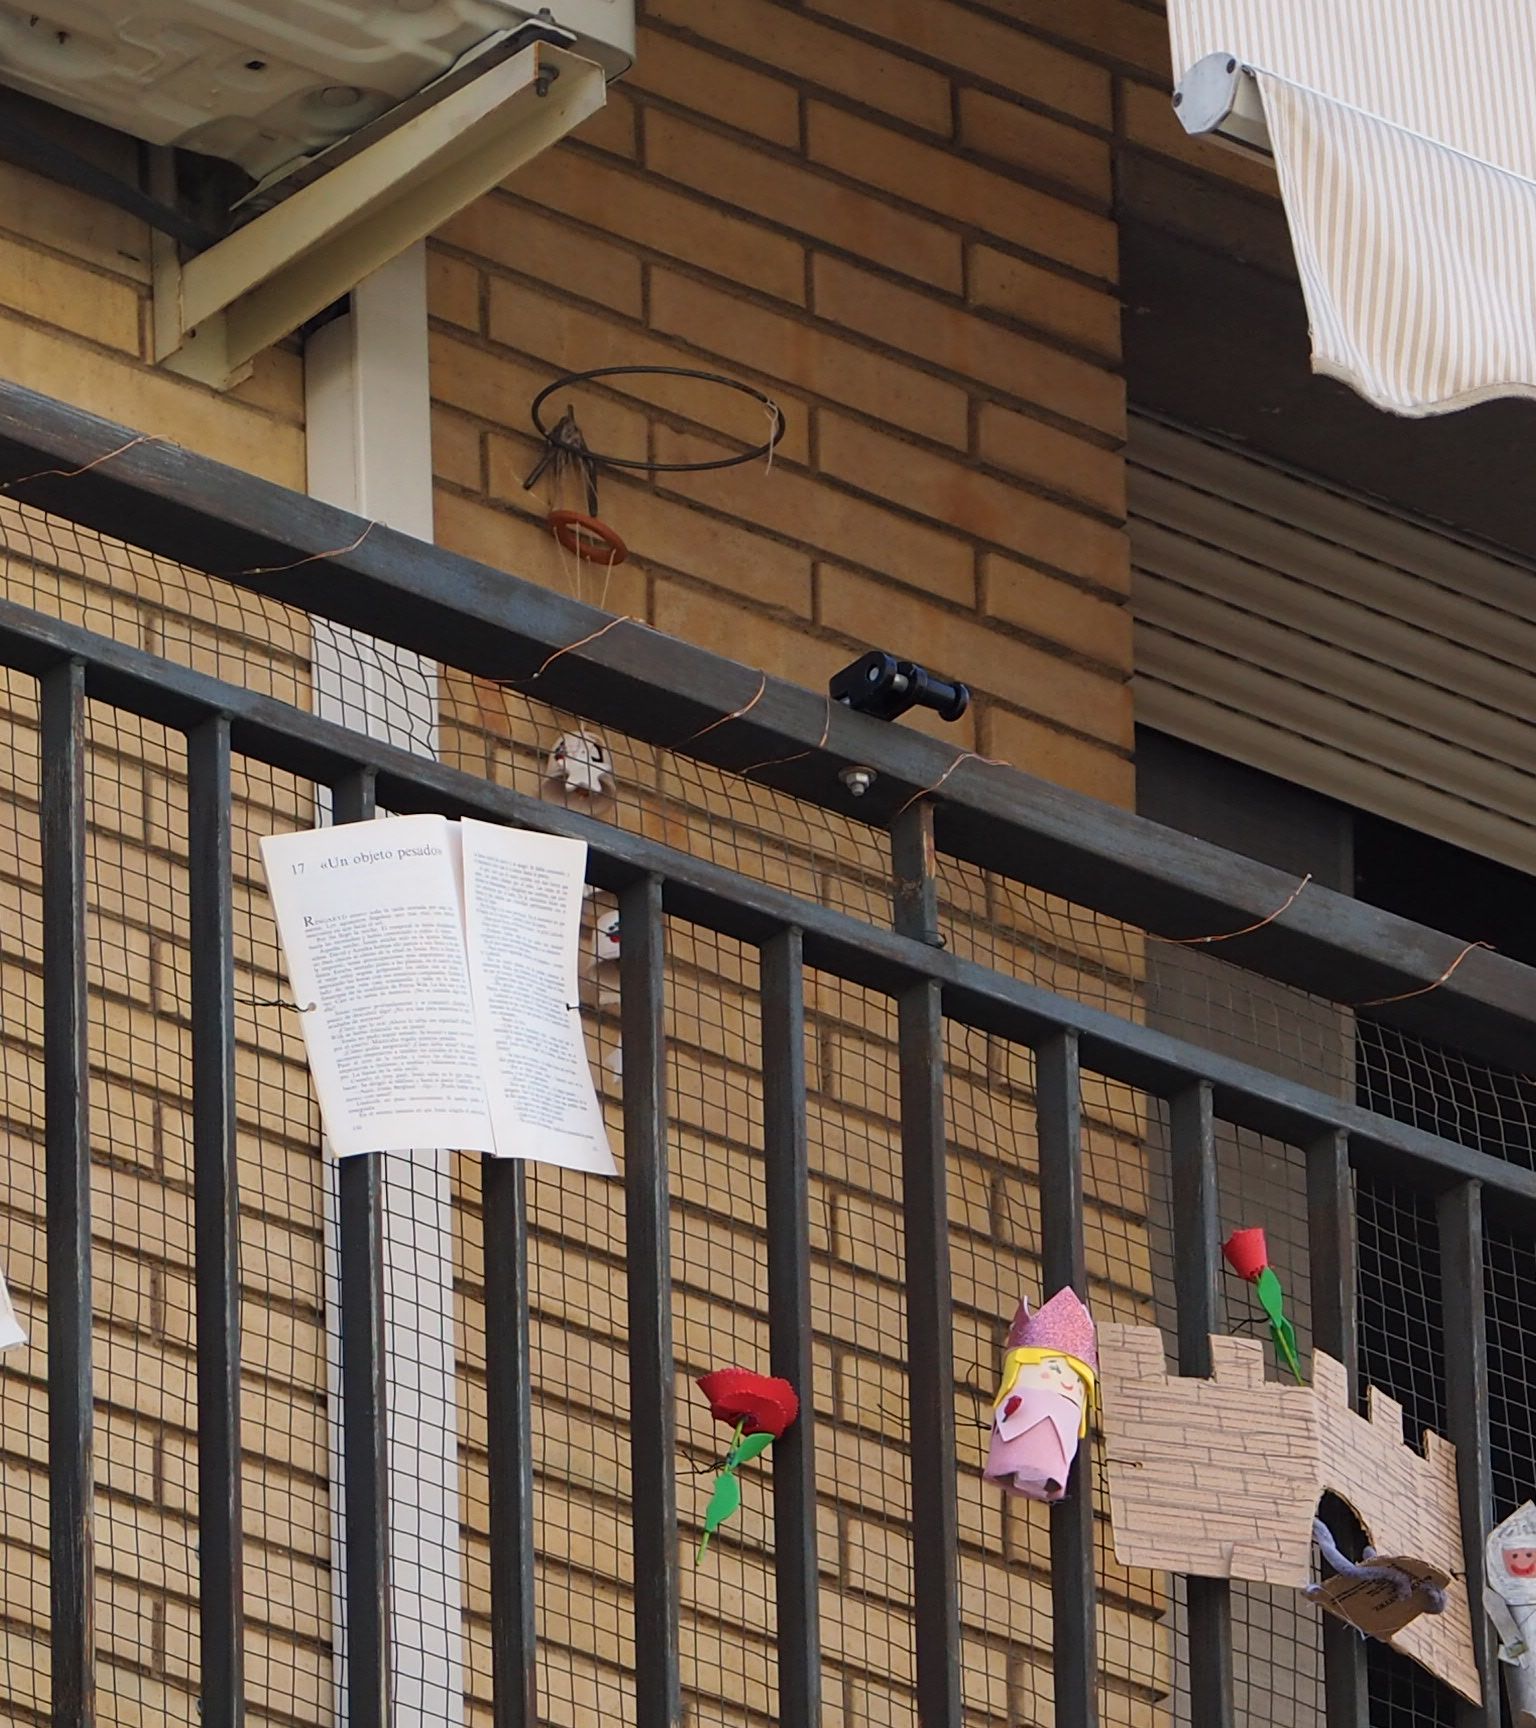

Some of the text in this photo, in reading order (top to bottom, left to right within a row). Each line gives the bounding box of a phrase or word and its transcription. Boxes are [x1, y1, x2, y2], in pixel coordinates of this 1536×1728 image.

[291, 862, 305, 876] 17
[320, 857, 349, 870] «Un
[353, 849, 393, 864] objeto
